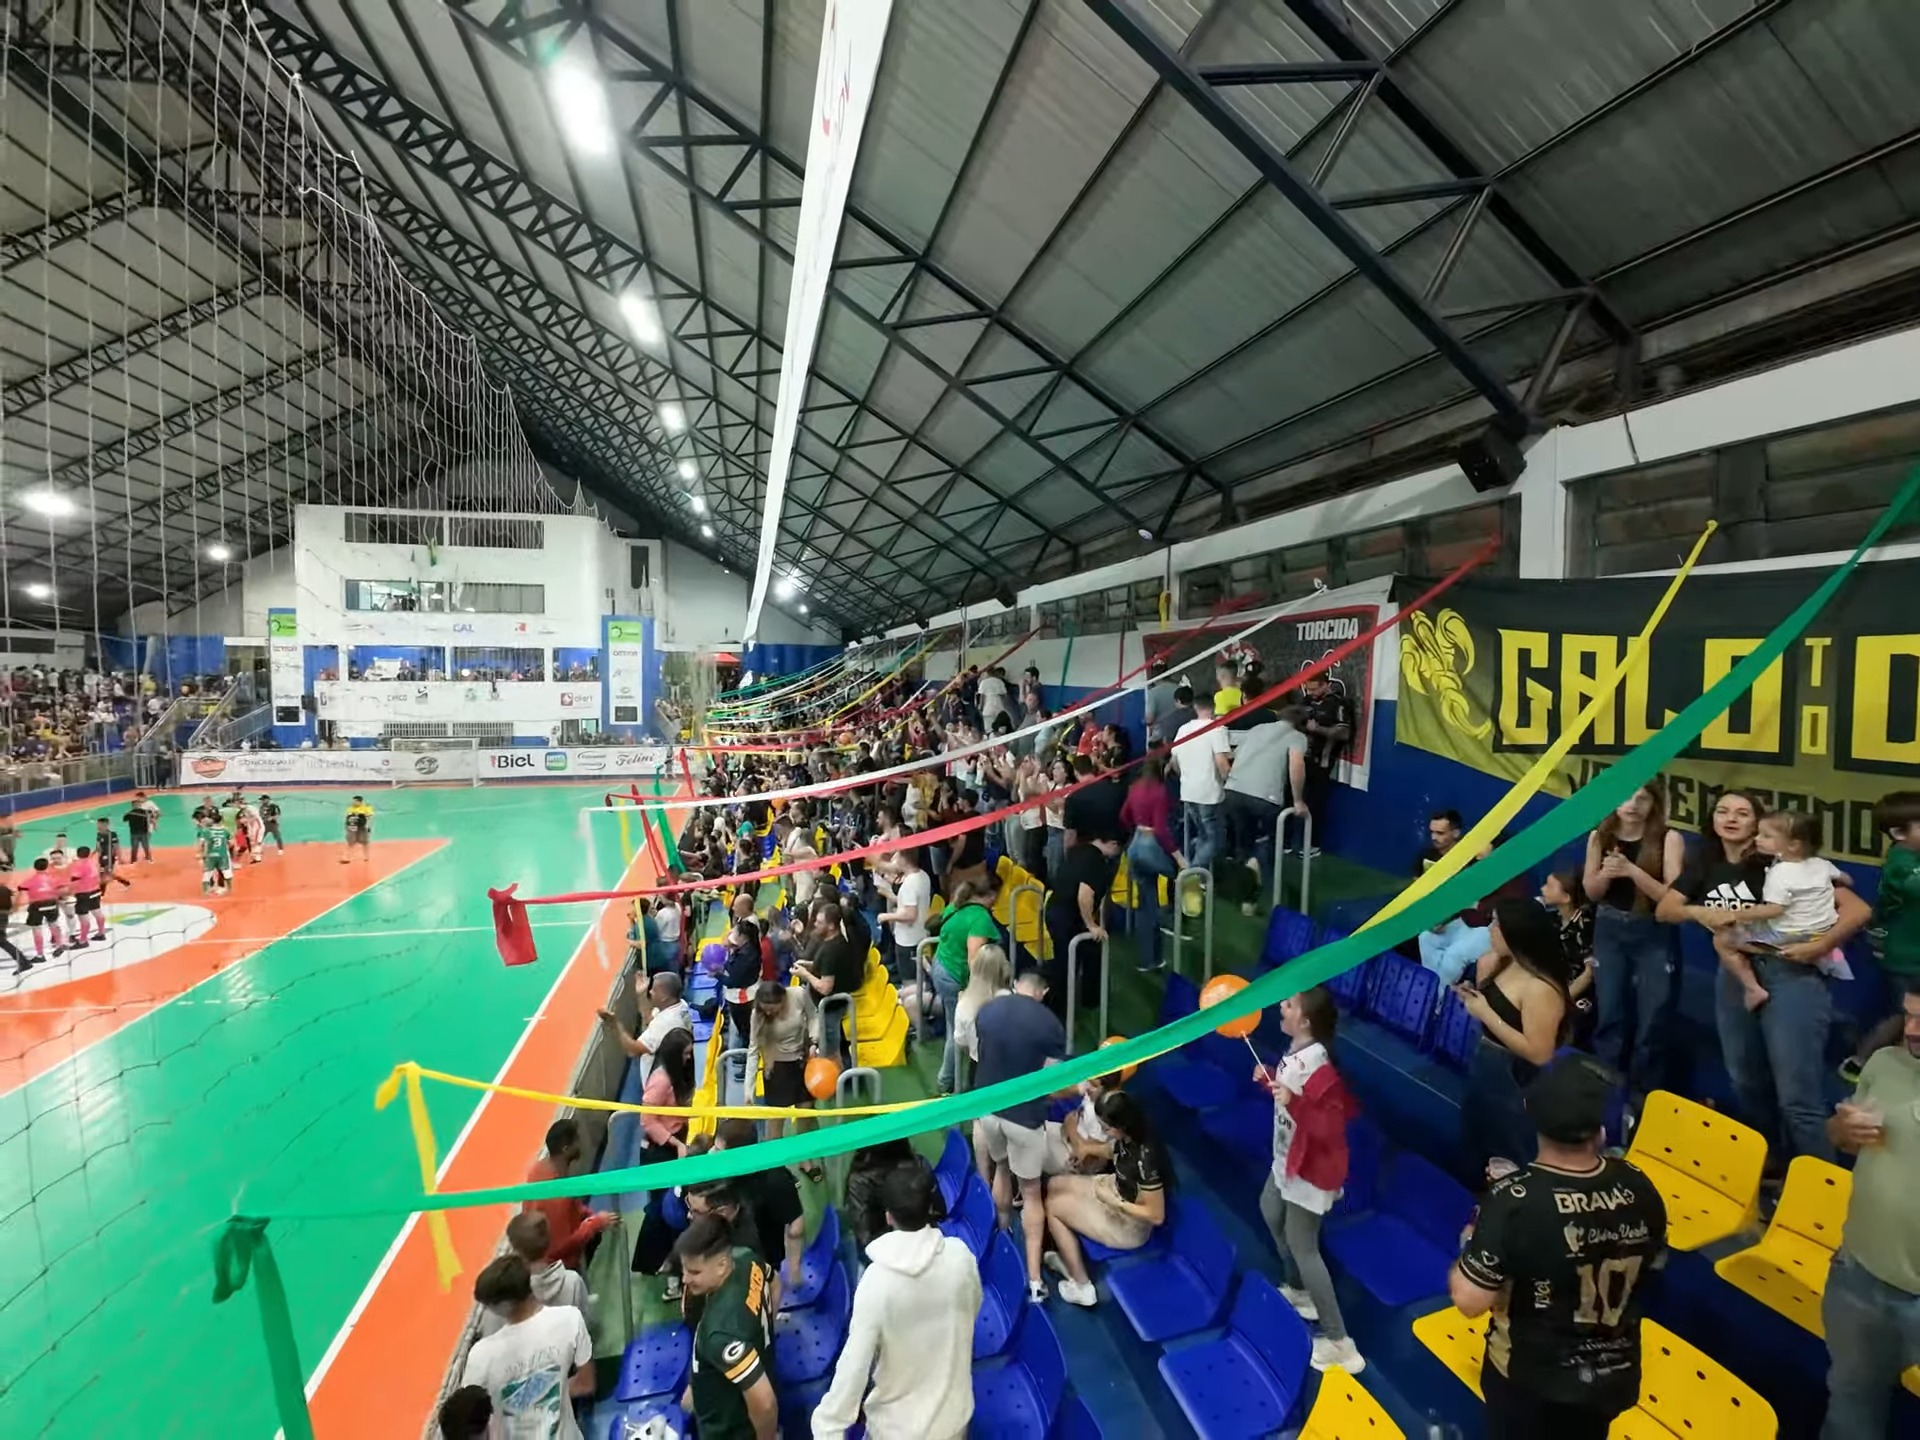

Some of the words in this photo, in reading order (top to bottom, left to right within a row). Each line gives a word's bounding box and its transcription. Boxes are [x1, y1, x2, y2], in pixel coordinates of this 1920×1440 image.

[1296, 618, 1359, 641] TORCIDA
[1497, 629, 1784, 753] GALO
[498, 754, 535, 768] Biel
[1573, 1255, 1643, 1327] 10
